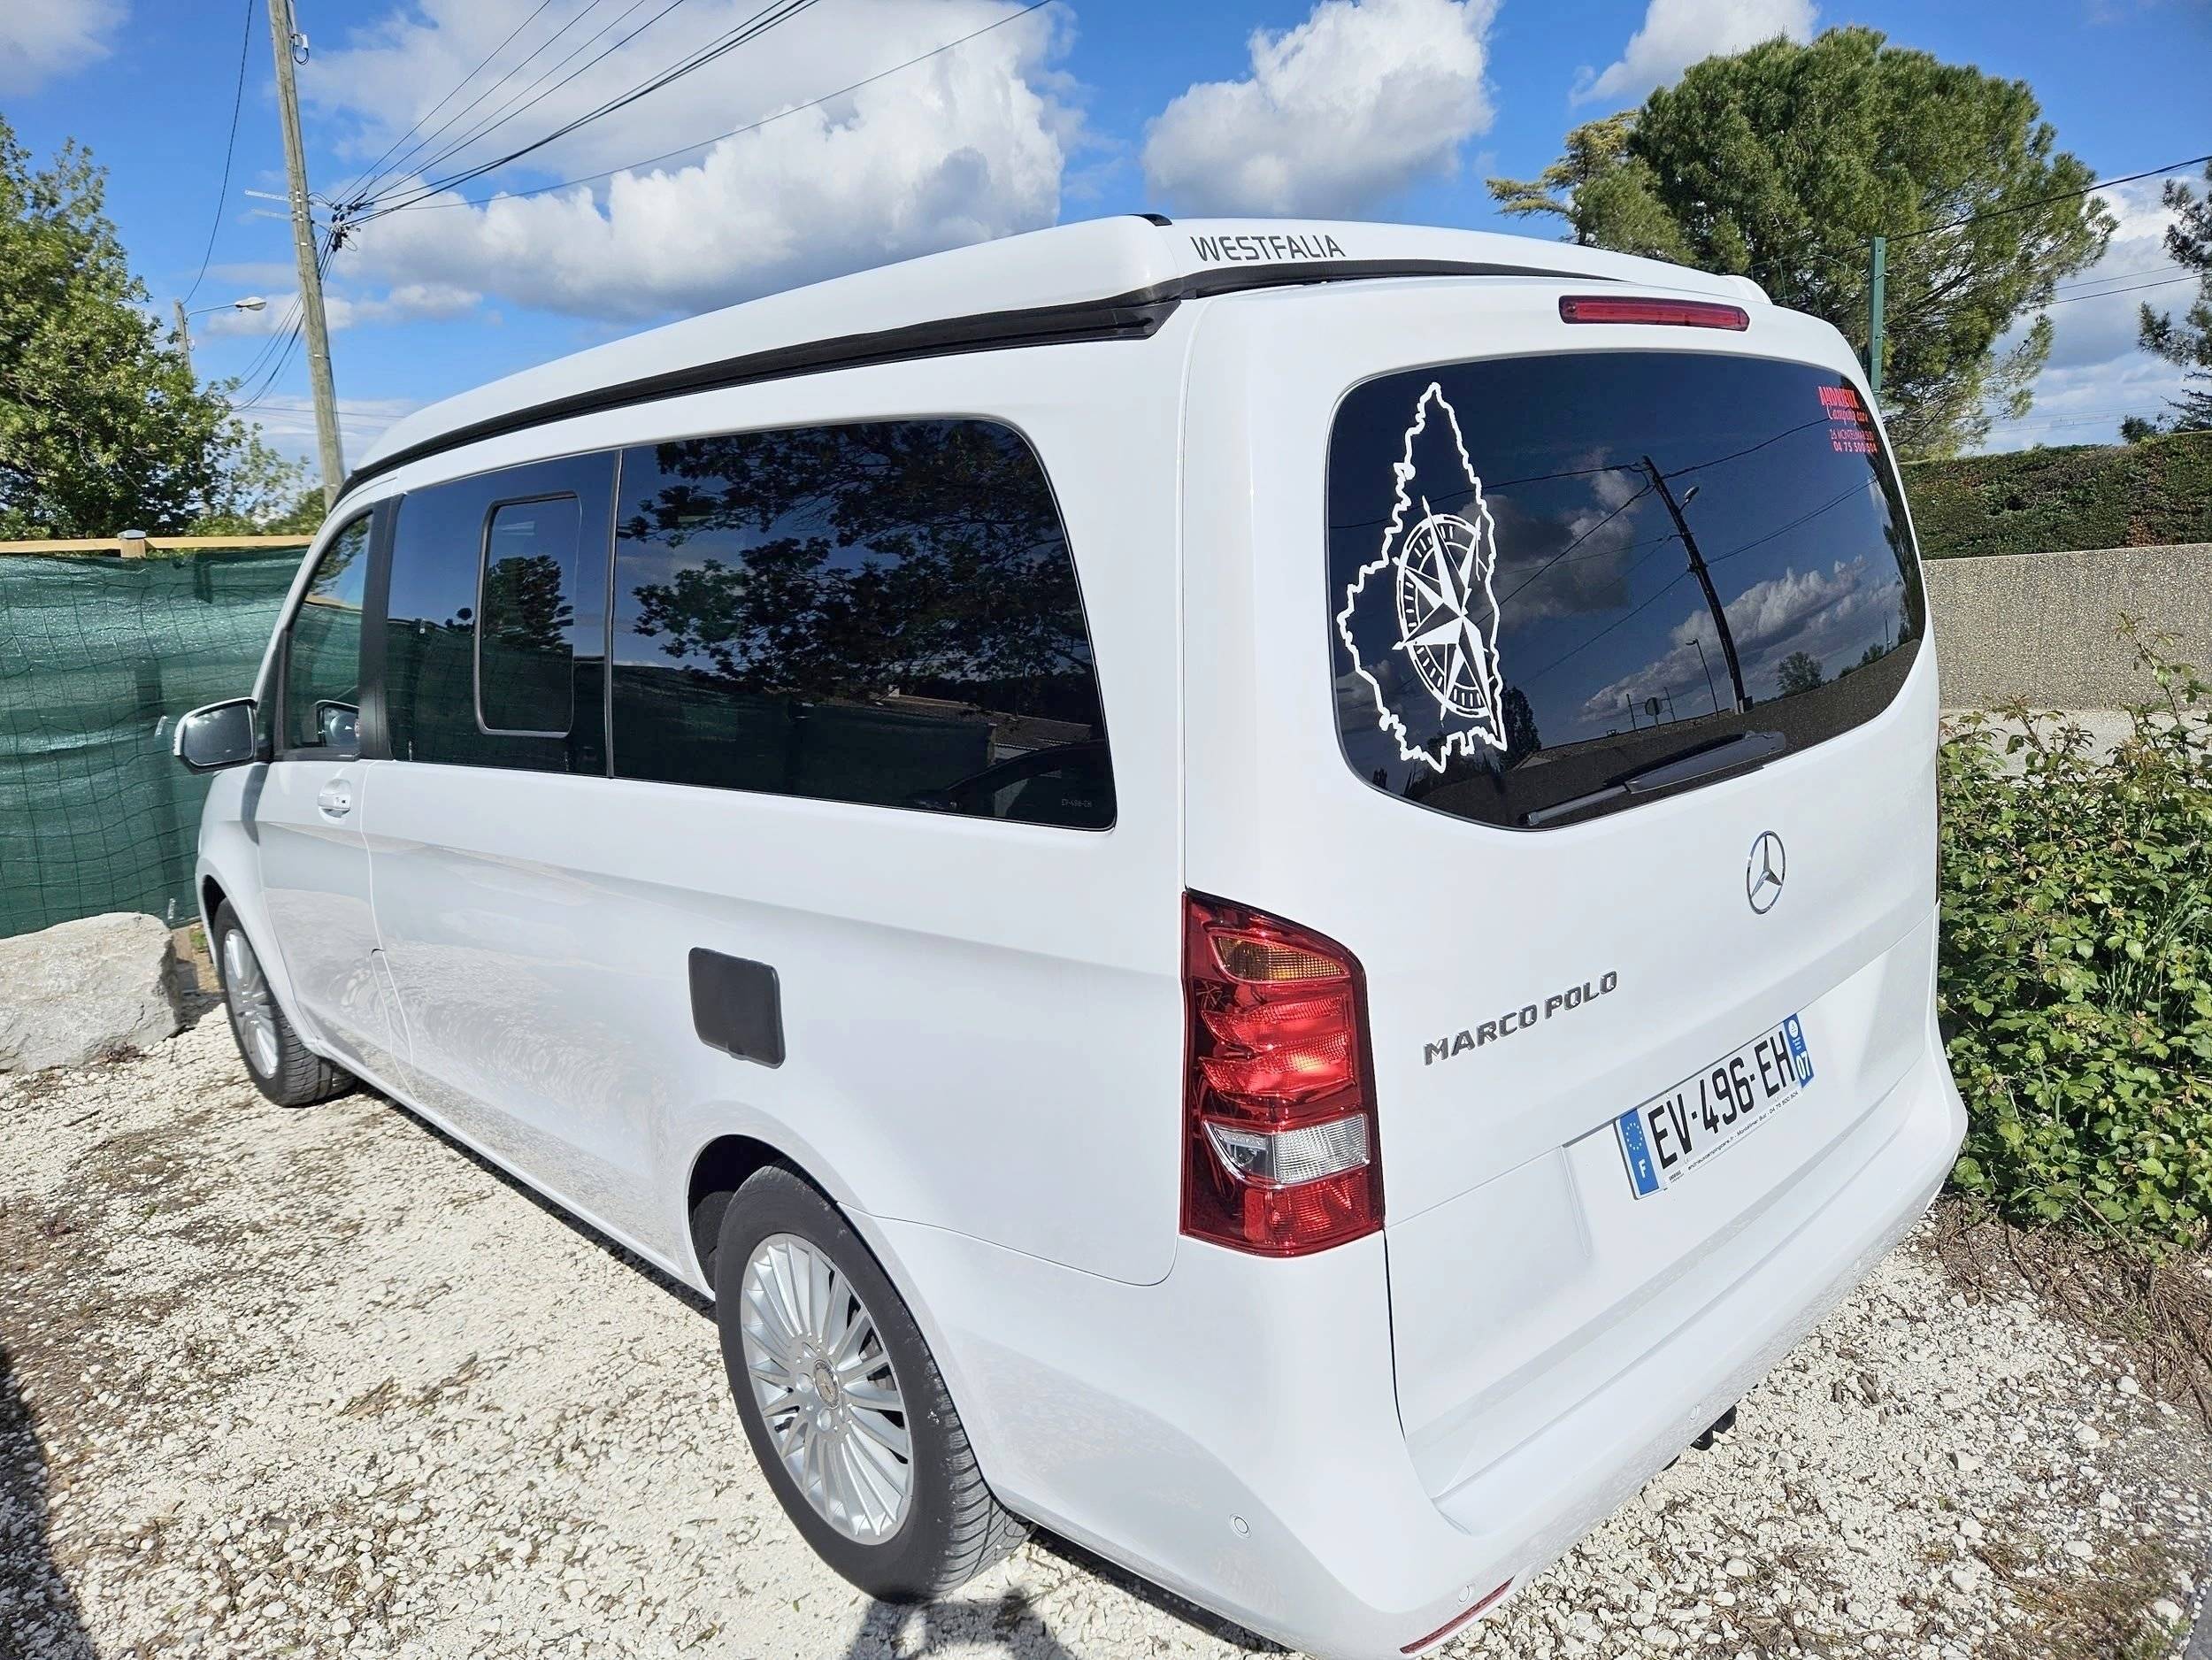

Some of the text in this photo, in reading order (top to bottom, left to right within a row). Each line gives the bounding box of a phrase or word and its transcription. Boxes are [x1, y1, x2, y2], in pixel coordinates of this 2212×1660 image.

[1189, 235, 1347, 262] WESTFALIA
[1833, 441, 1843, 452] 04
[1843, 442, 1853, 452] 75
[1423, 970, 1618, 1066] MARCO POLO
[1794, 1050, 1813, 1081] 07
[1647, 1029, 1797, 1171] EV-496-EH
[1638, 1158, 1647, 1180] F
